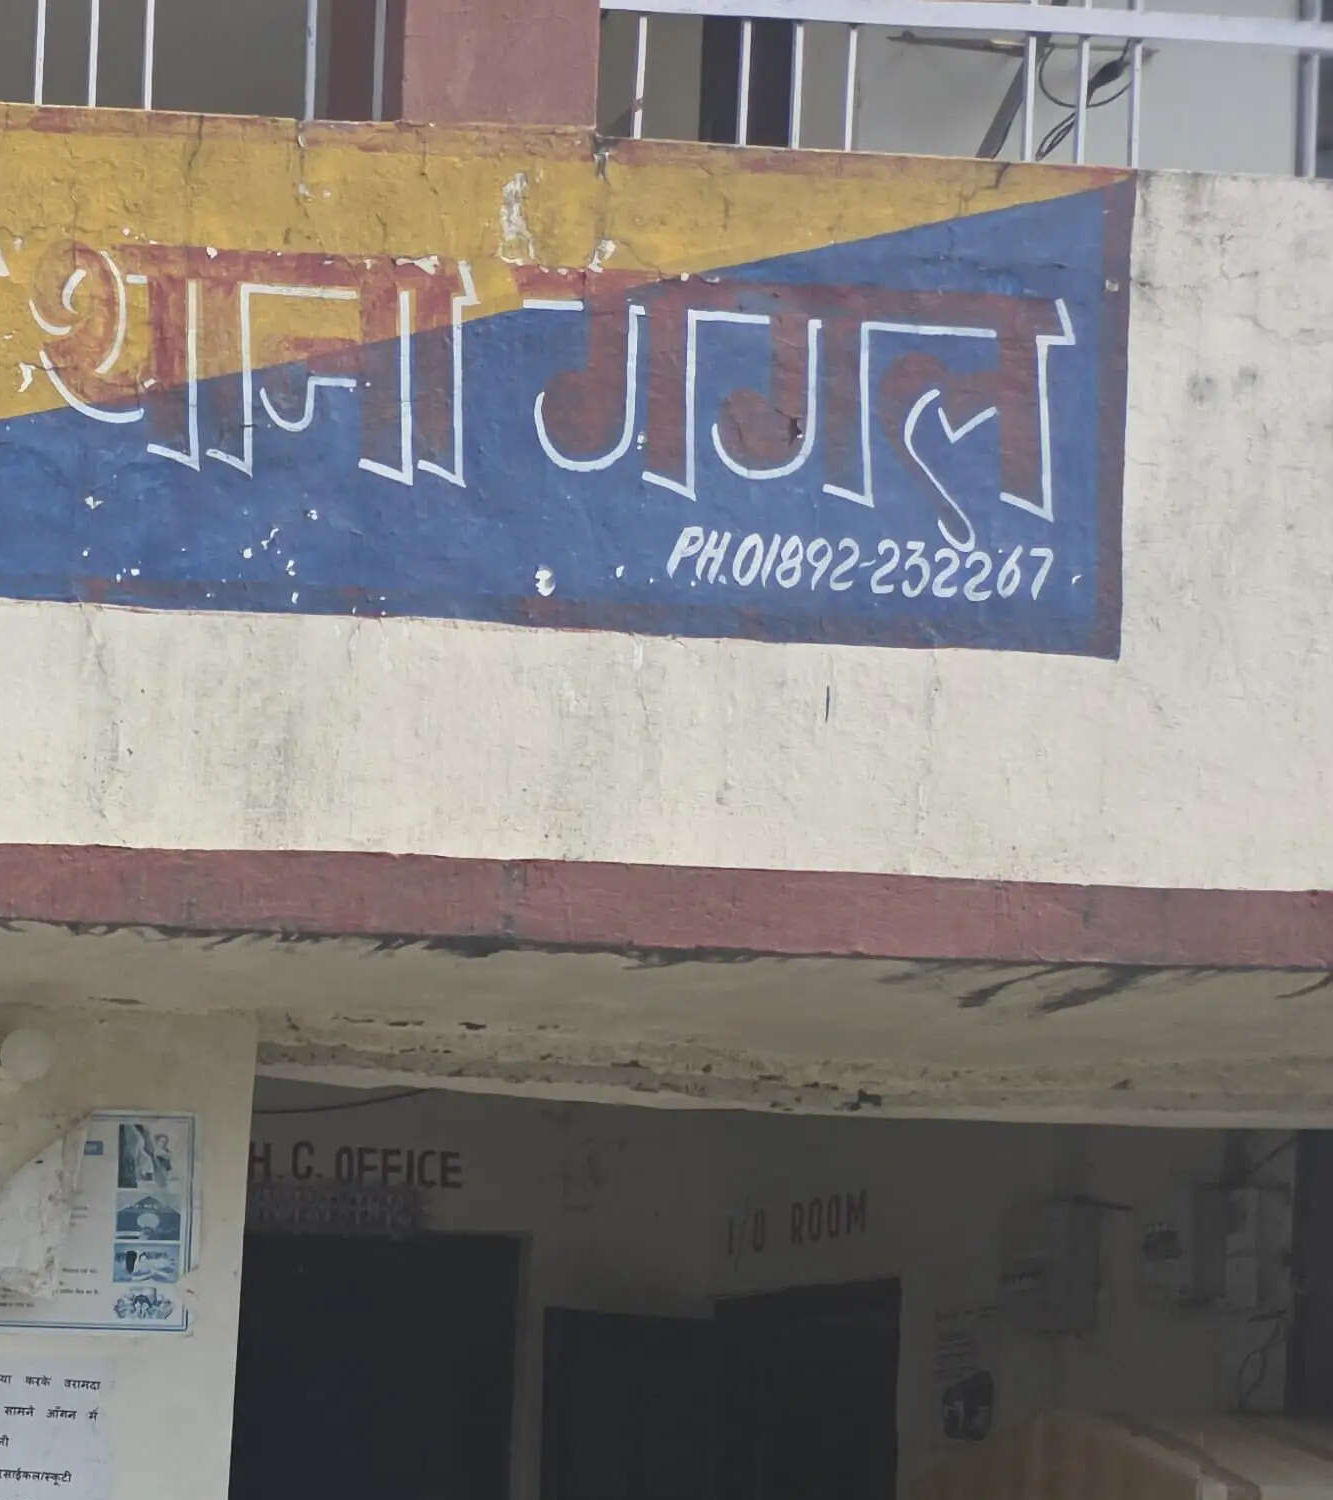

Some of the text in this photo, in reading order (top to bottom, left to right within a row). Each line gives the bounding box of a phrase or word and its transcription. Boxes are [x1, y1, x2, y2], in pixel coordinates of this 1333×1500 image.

[26, 240, 479, 488] थाना
[513, 263, 1076, 551] गगल
[334, 1145, 463, 1189] OFFICE
[789, 1188, 868, 1246] ROOM
[4, 1405, 35, 1416] सामने
